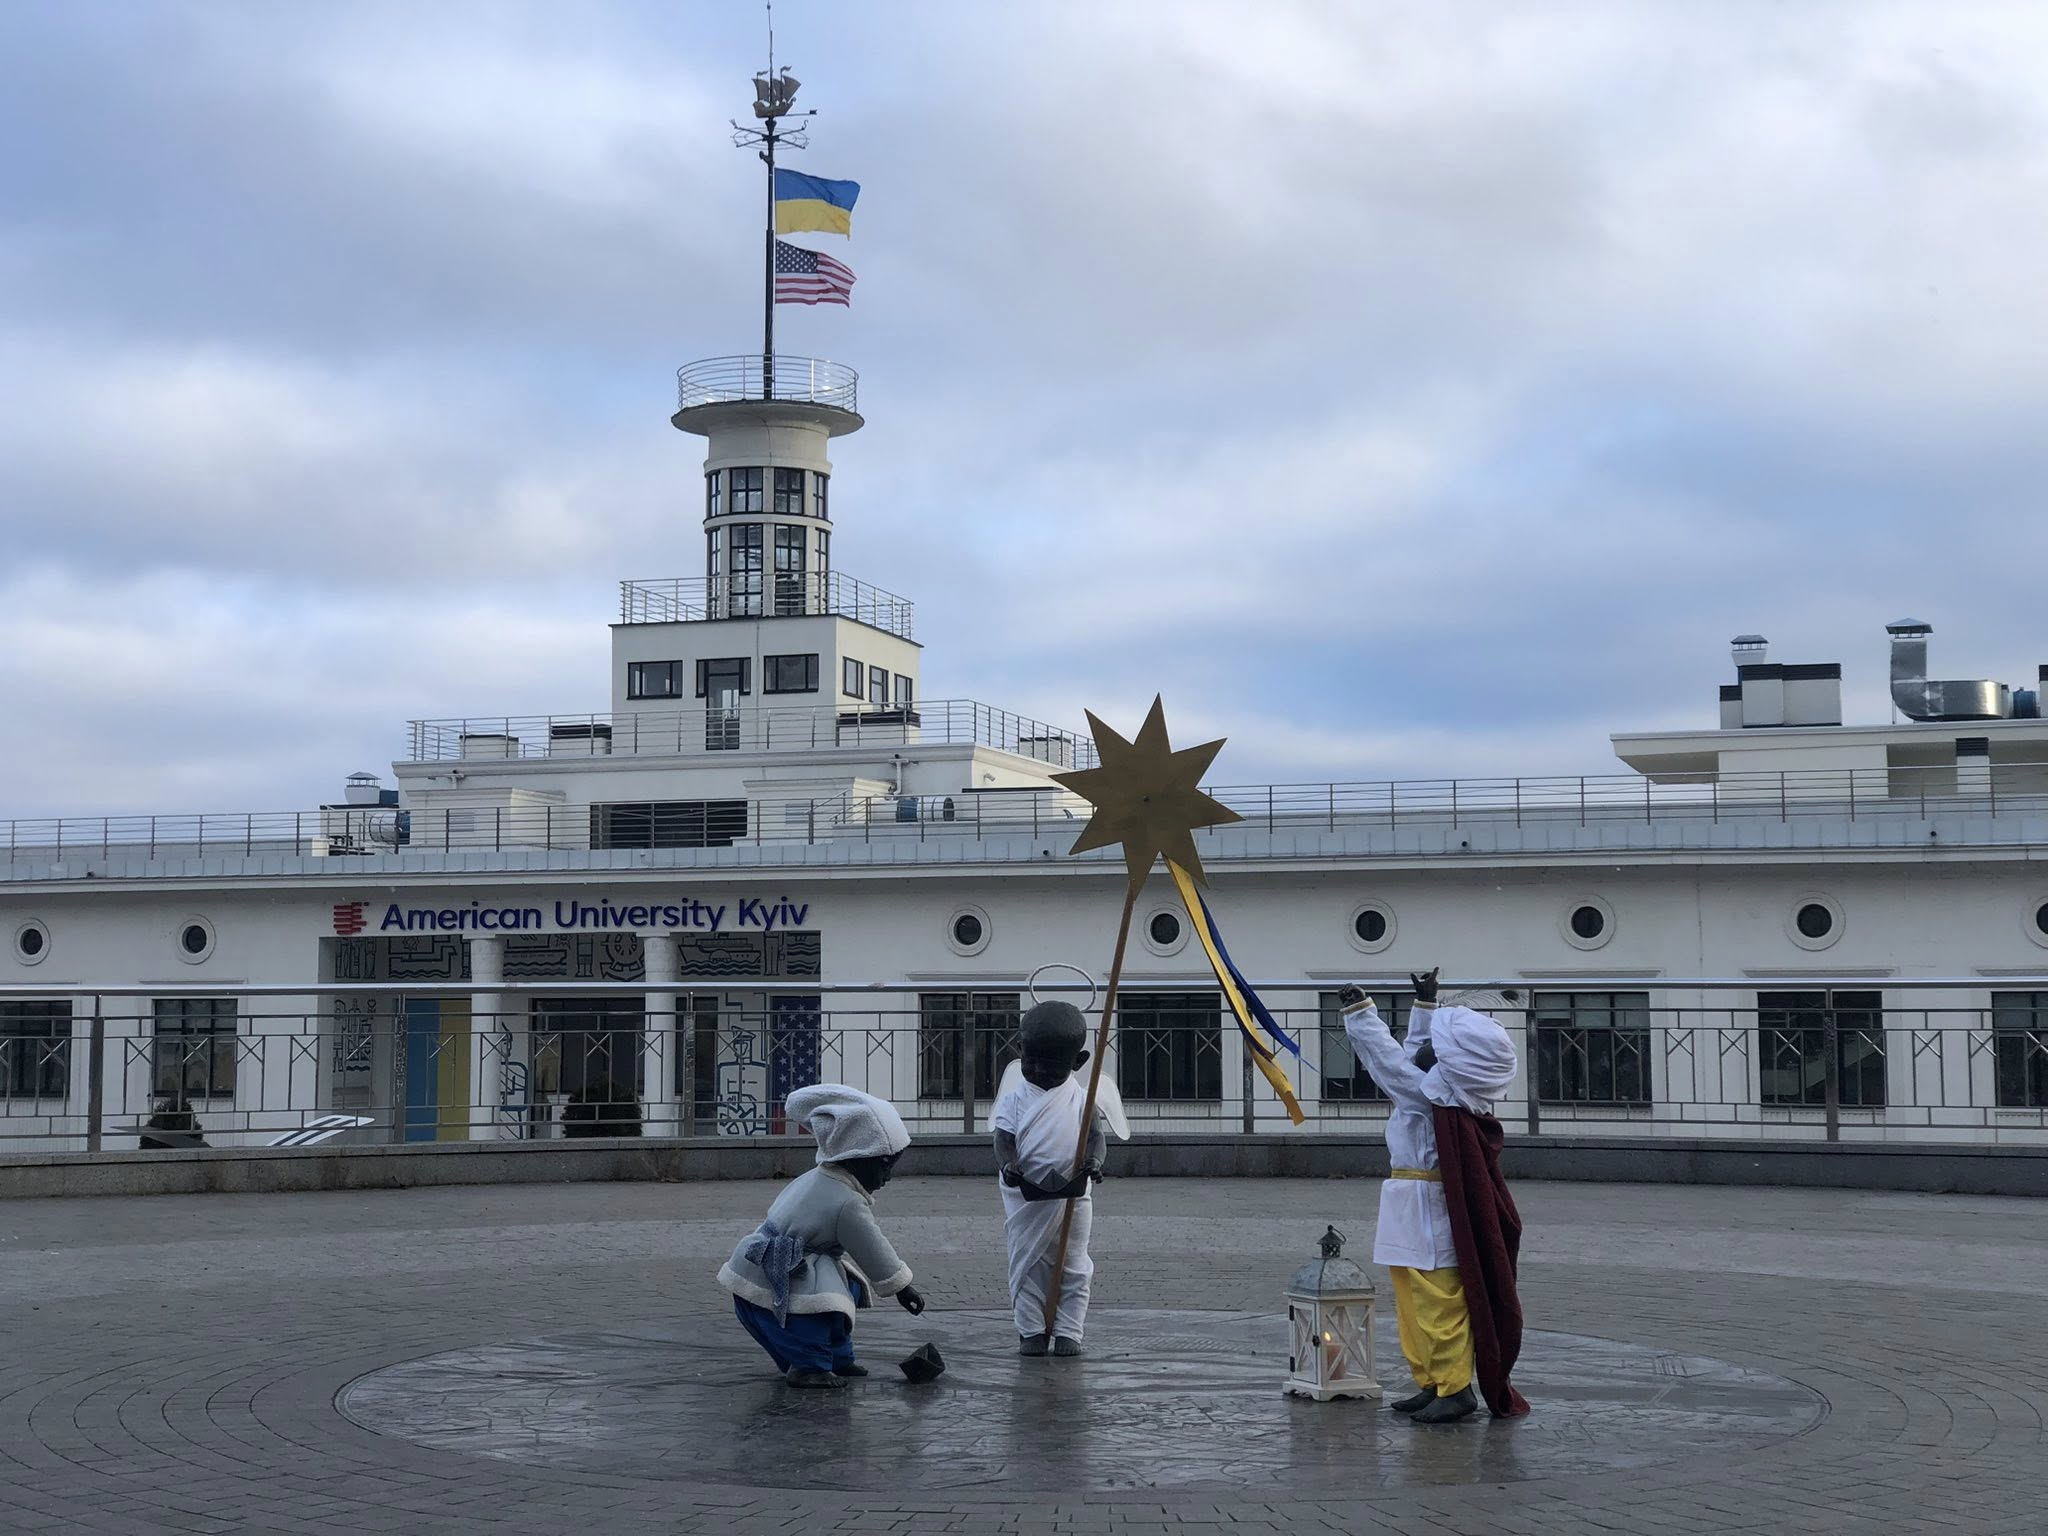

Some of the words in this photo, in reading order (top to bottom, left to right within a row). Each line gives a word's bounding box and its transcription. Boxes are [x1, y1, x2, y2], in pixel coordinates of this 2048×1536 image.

[380, 901, 542, 930] American
[555, 897, 726, 931] University
[738, 896, 809, 931] Kyiv
